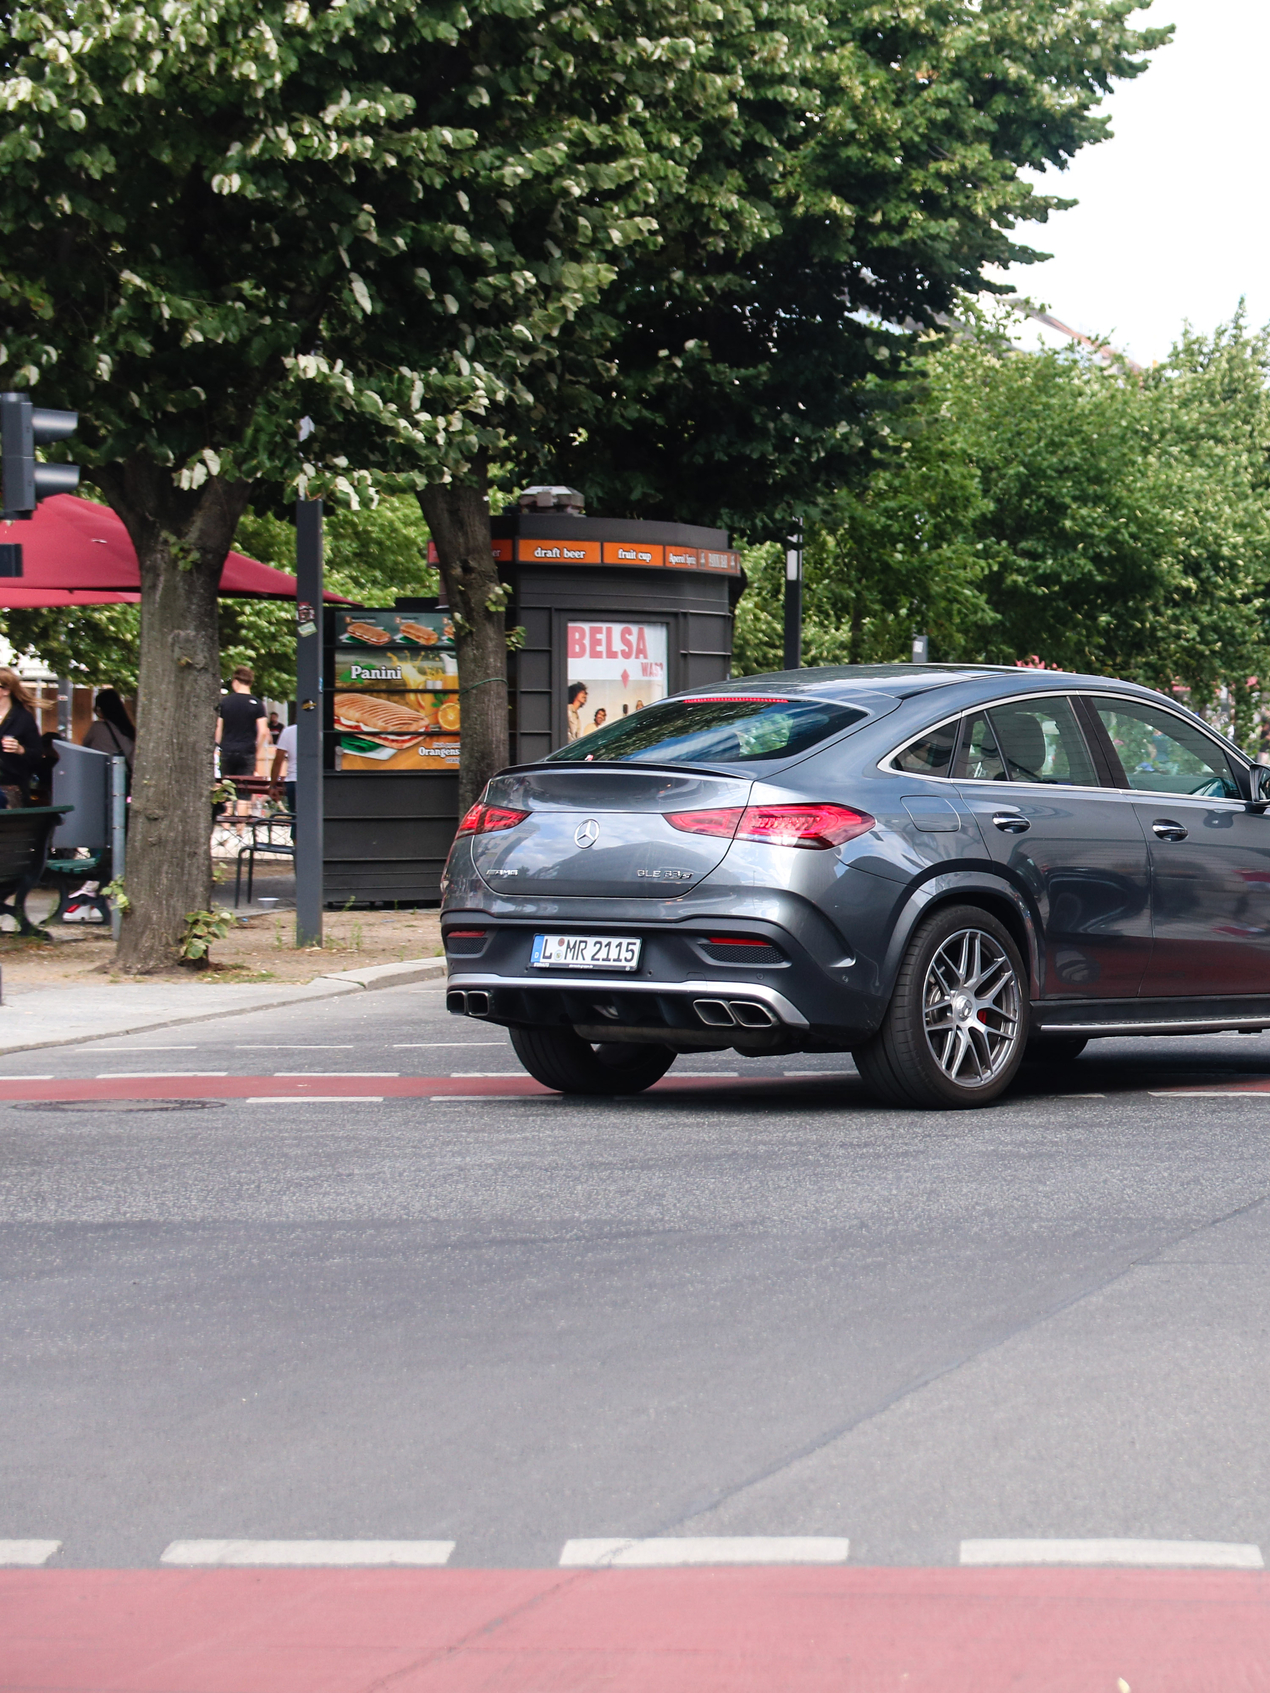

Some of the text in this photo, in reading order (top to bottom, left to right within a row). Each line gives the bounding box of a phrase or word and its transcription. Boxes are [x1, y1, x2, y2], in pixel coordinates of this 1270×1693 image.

[534, 547, 586, 559] draft beer
[618, 548, 652, 563] fruit cup
[568, 626, 648, 660] BELSA
[350, 665, 402, 680] Panini
[542, 939, 637, 963] L MR 2115
